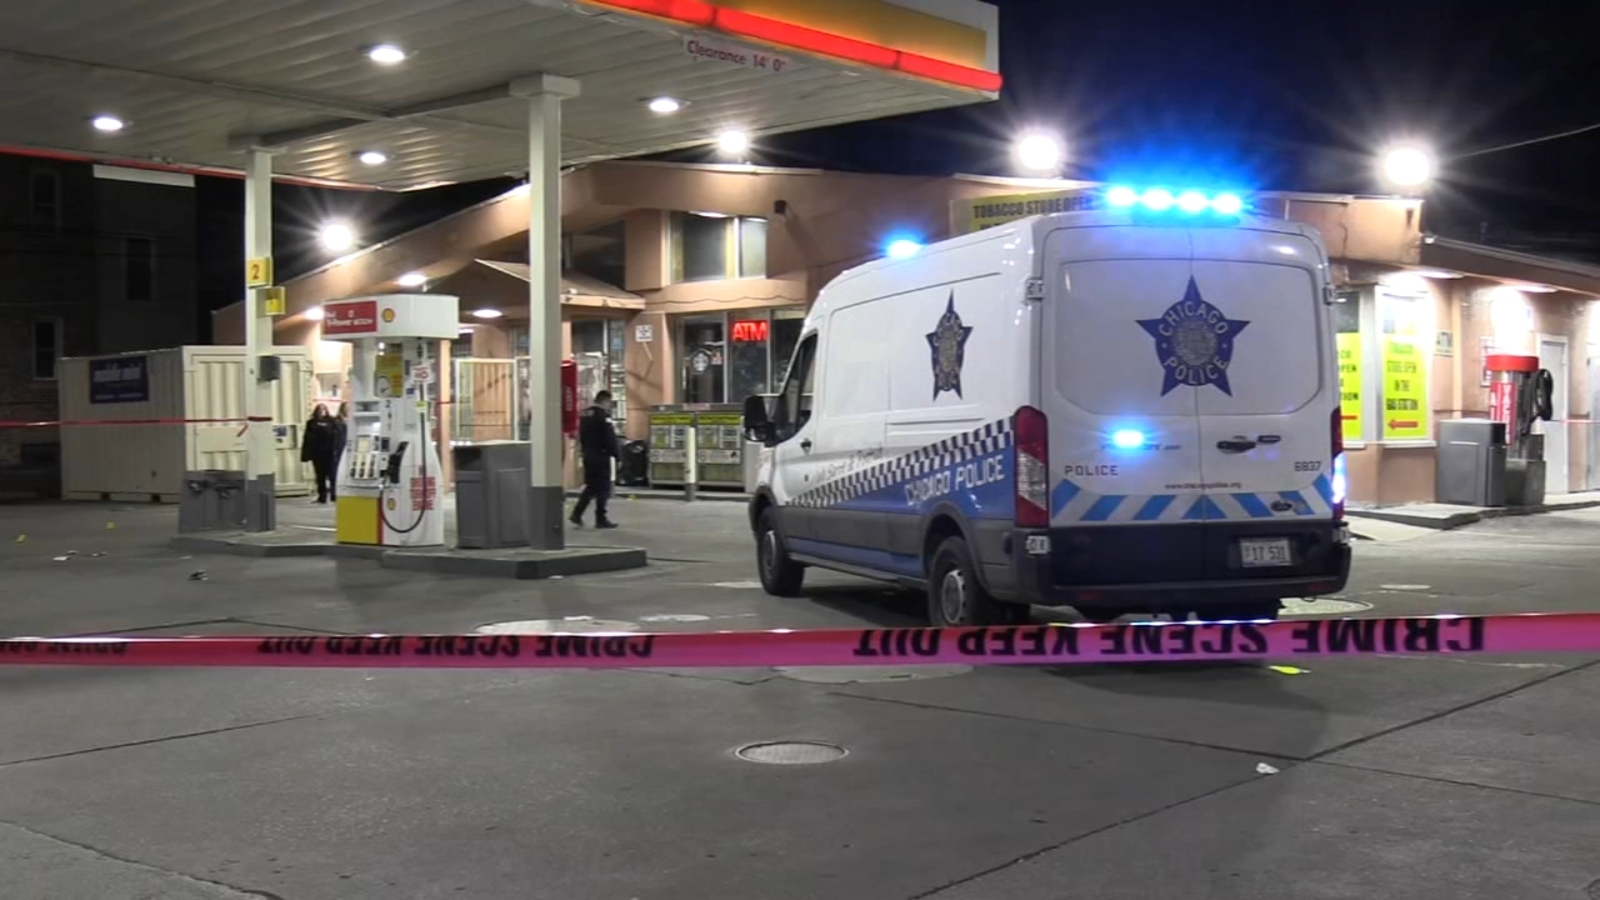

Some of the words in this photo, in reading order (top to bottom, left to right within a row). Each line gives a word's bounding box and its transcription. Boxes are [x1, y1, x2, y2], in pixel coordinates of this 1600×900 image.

[687, 39, 746, 65] Clearance
[973, 201, 1024, 219] TOBACCO
[1026, 199, 1061, 216] STORE
[251, 263, 260, 280] 2
[732, 320, 769, 342] ATM
[1158, 300, 1229, 337] CHICAGO
[1163, 355, 1227, 384] POLICE
[905, 470, 951, 507] CHICAGO
[955, 455, 1005, 491] POLICE
[1064, 465, 1118, 476] POLICE
[853, 628, 943, 657] OUT
[956, 625, 1081, 656] KEEP
[1099, 621, 1268, 656] SCENE
[1291, 616, 1484, 654] CRIME
